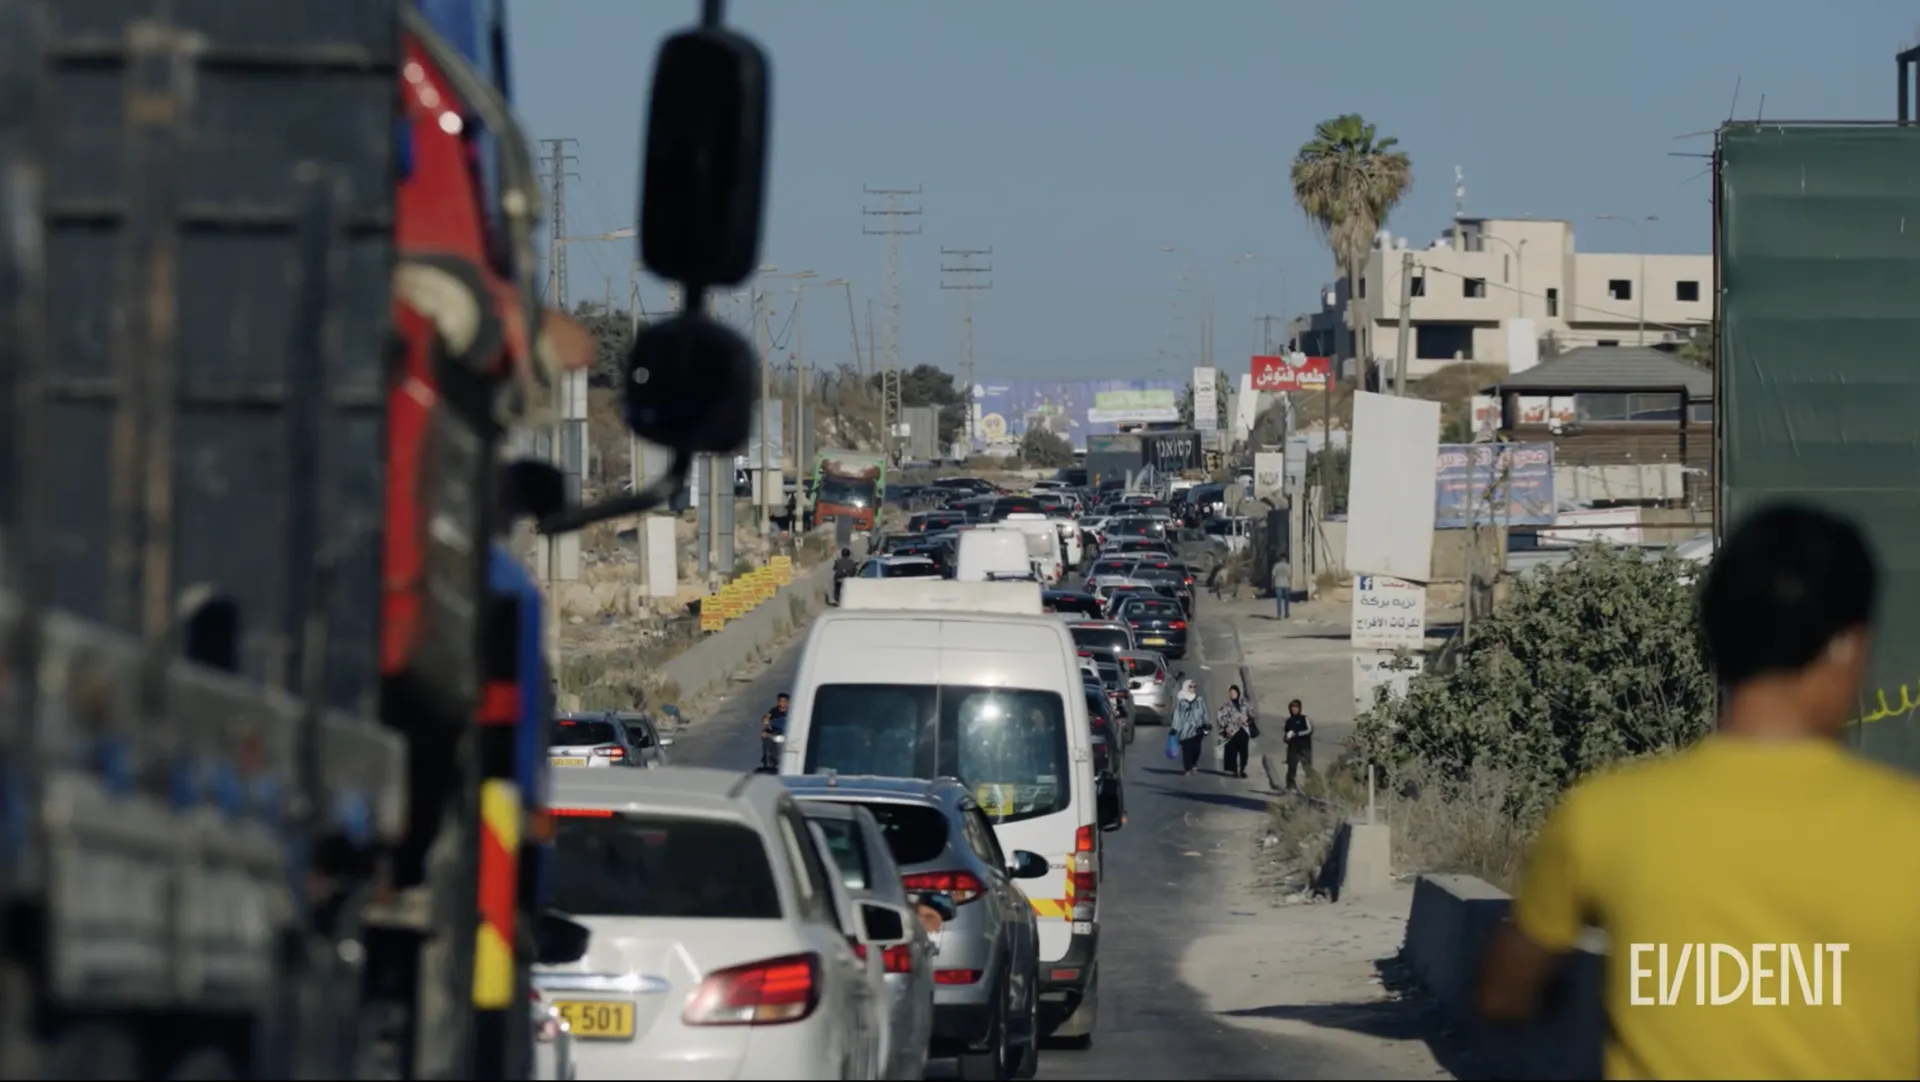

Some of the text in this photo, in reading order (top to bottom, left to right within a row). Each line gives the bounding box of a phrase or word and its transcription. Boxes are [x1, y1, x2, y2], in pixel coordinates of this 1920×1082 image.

[1256, 364, 1331, 387] طعم فتوش
[582, 1005, 623, 1031] 501
